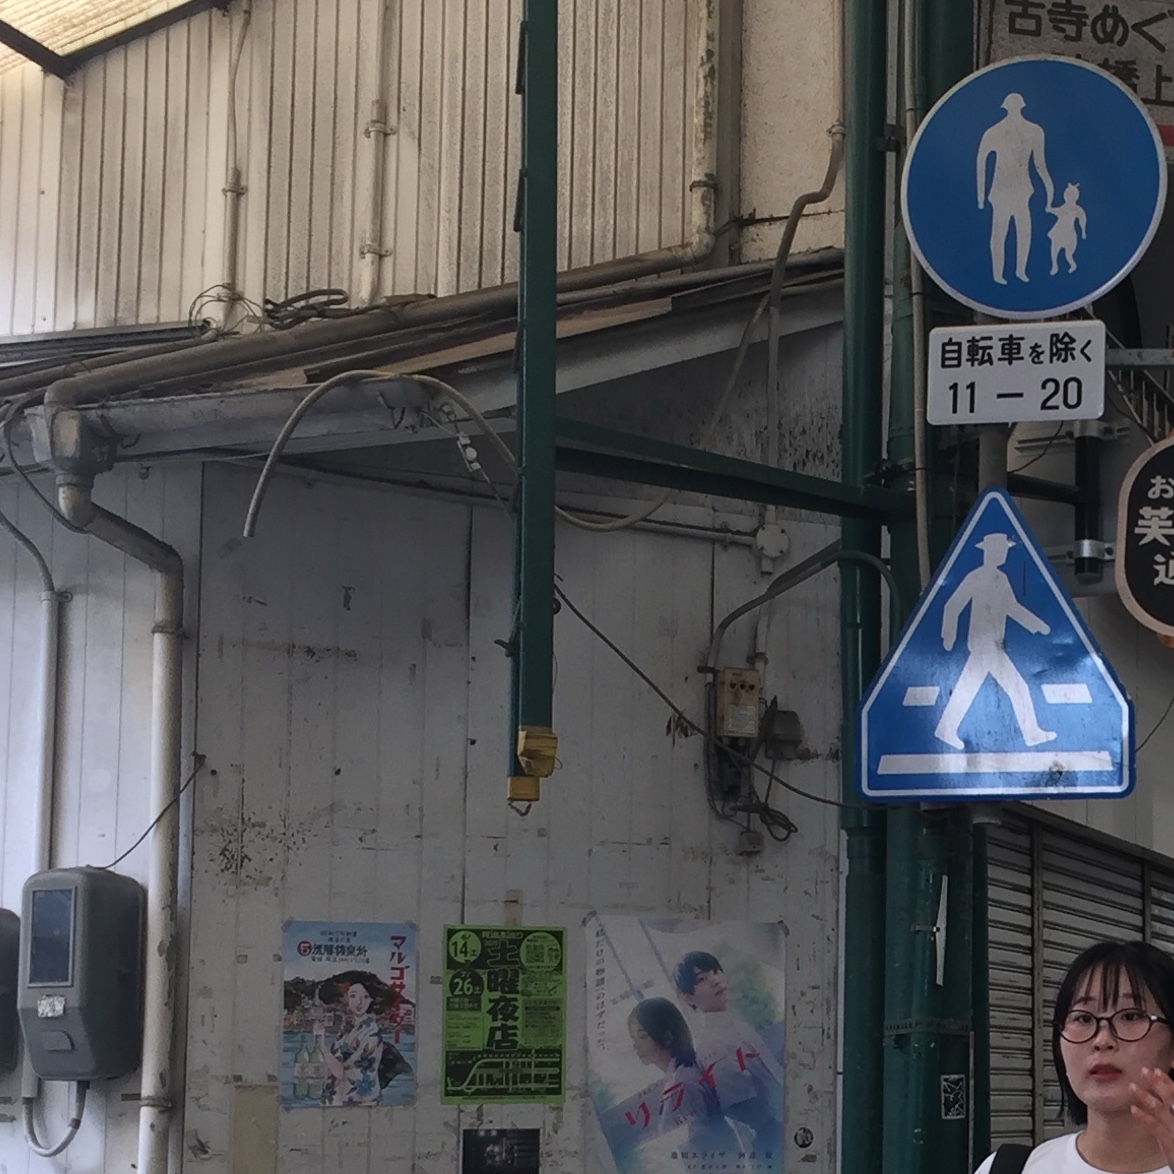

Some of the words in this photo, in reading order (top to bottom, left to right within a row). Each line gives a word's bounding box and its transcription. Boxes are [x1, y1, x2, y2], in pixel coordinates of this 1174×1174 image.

[940, 332, 1093, 369] 自転車を除く
[948, 382, 977, 414] 11
[1040, 377, 1083, 411] 20
[625, 1046, 761, 1128] リライト
